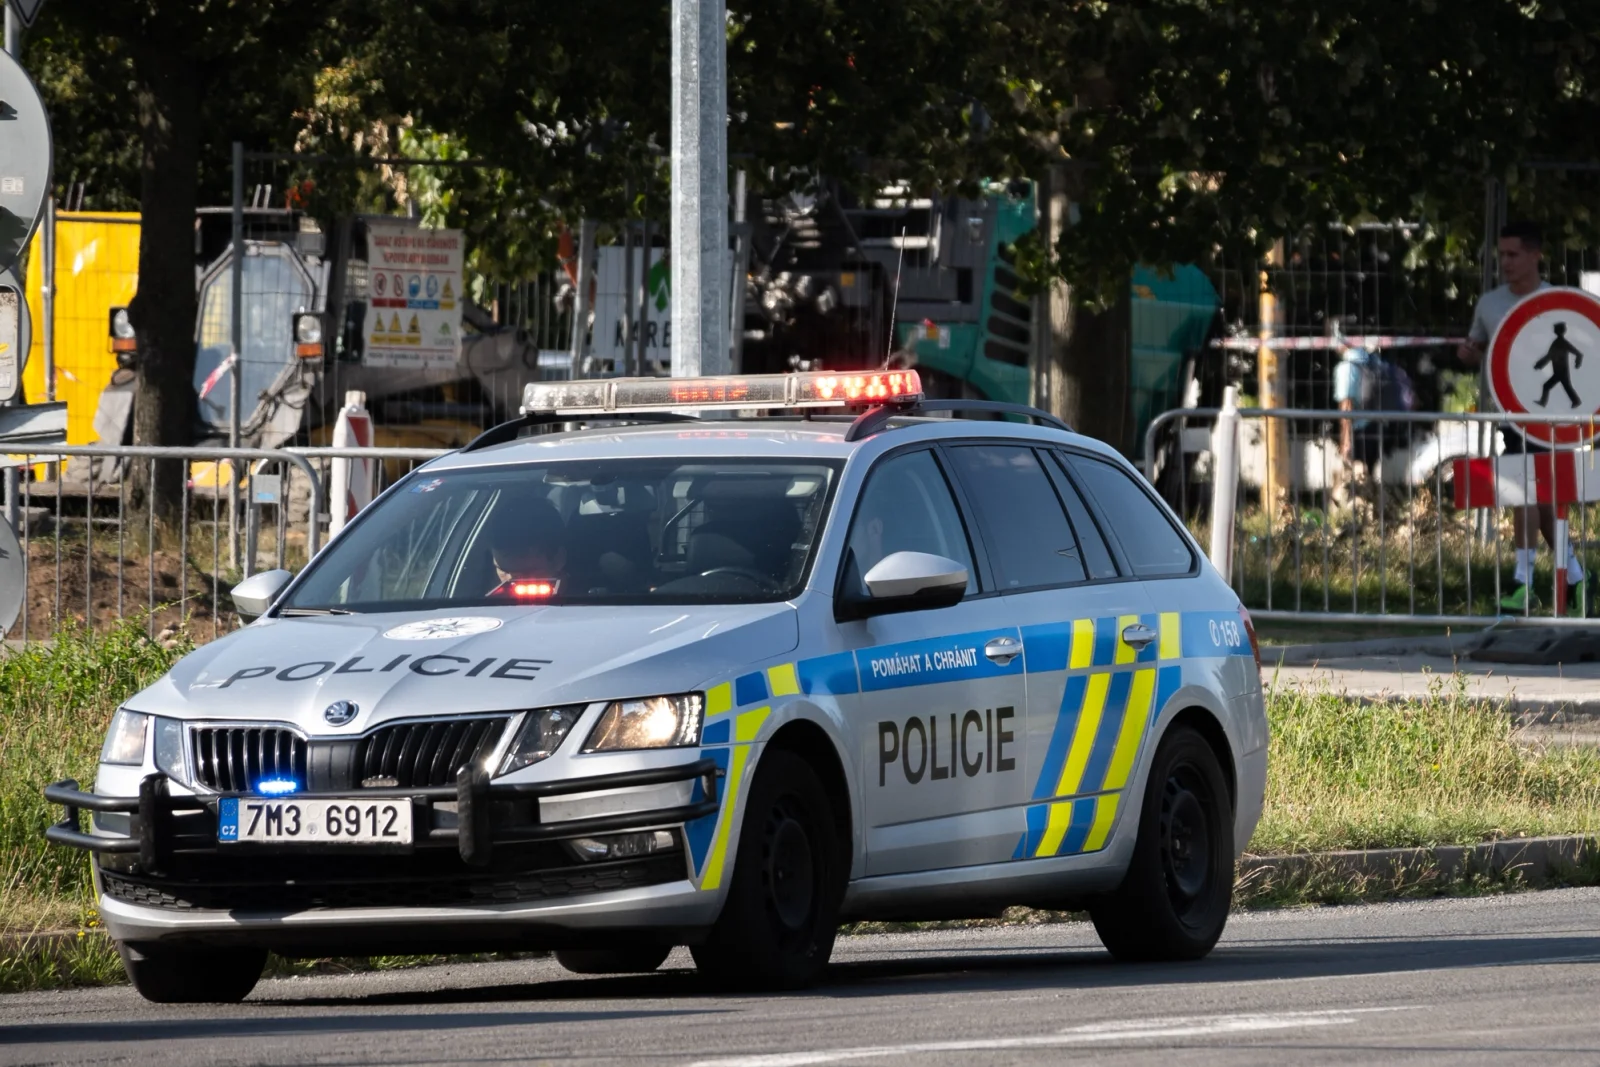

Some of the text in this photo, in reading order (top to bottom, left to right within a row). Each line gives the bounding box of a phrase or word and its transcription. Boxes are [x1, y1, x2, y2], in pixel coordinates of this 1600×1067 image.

[1220, 620, 1241, 647] 158
[218, 653, 553, 689] POLICIE
[870, 645, 977, 678] POMÁHAT A CHRÁNIT
[878, 705, 1016, 787] POLICIE
[221, 825, 237, 836] CZ
[246, 804, 399, 837] 7M3 6912
